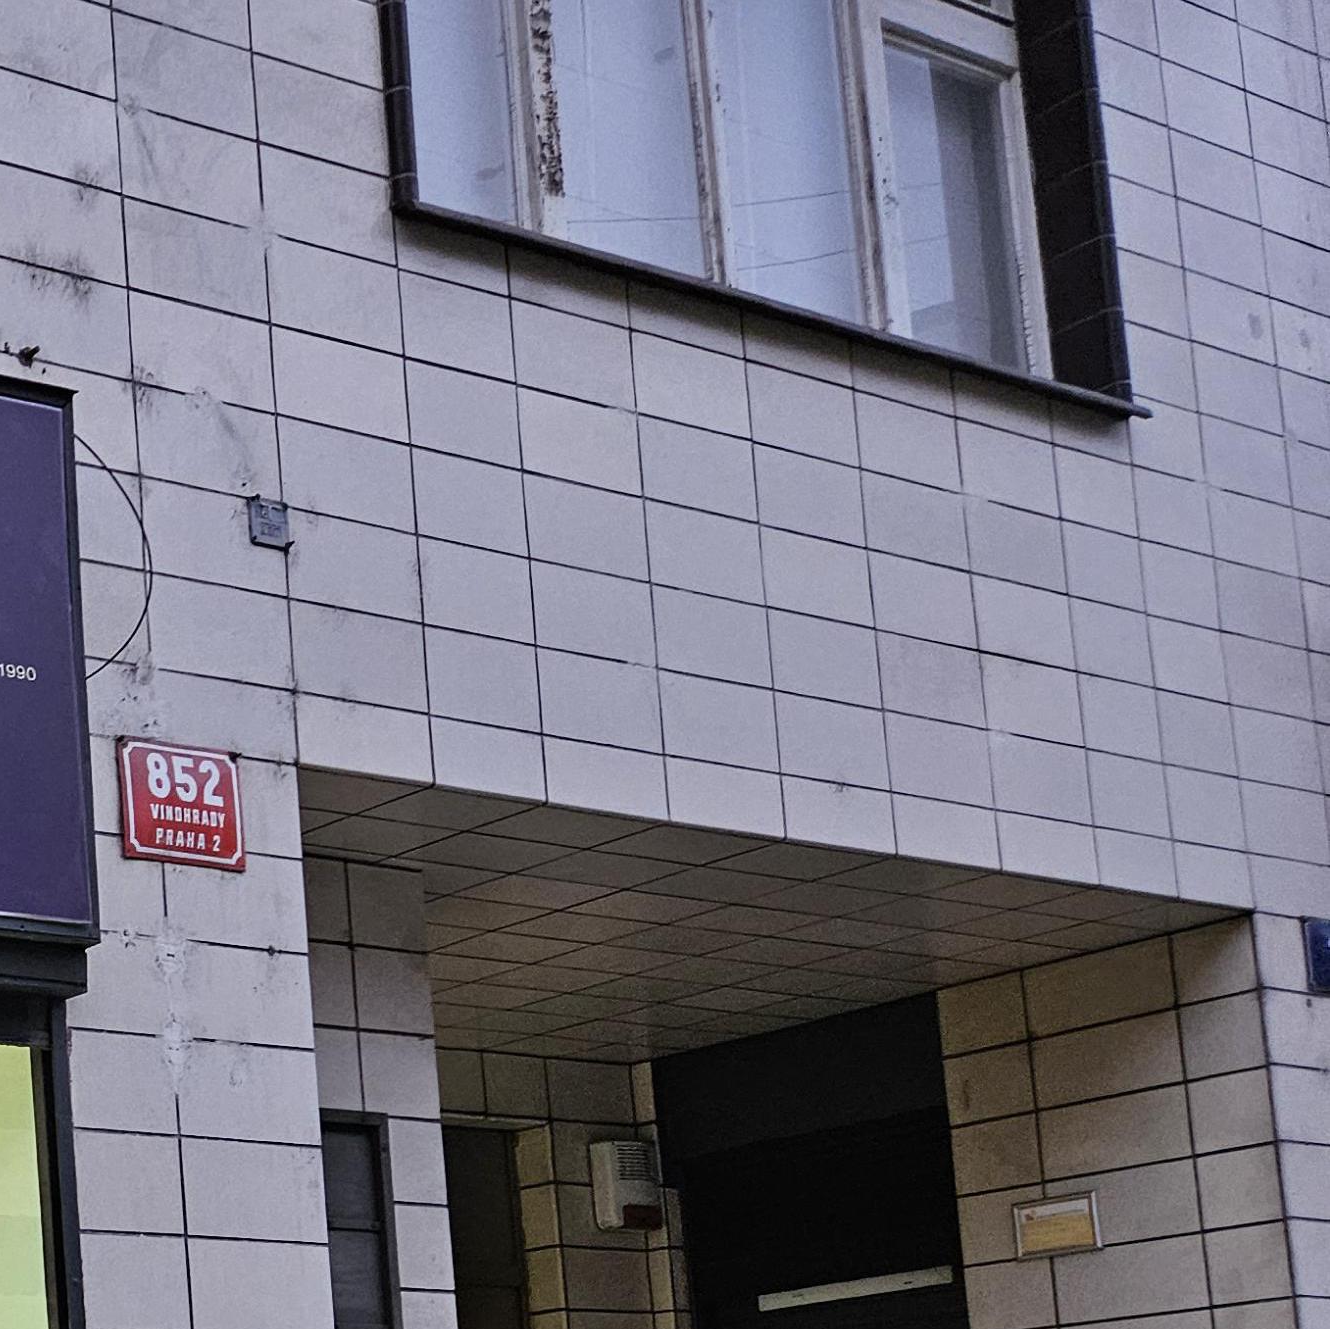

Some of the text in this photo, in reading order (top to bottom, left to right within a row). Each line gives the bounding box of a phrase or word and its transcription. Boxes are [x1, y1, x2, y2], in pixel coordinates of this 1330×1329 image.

[146, 752, 224, 808] 852
[149, 803, 226, 829] VINOHRADY
[155, 827, 221, 852] PRAHA 2
